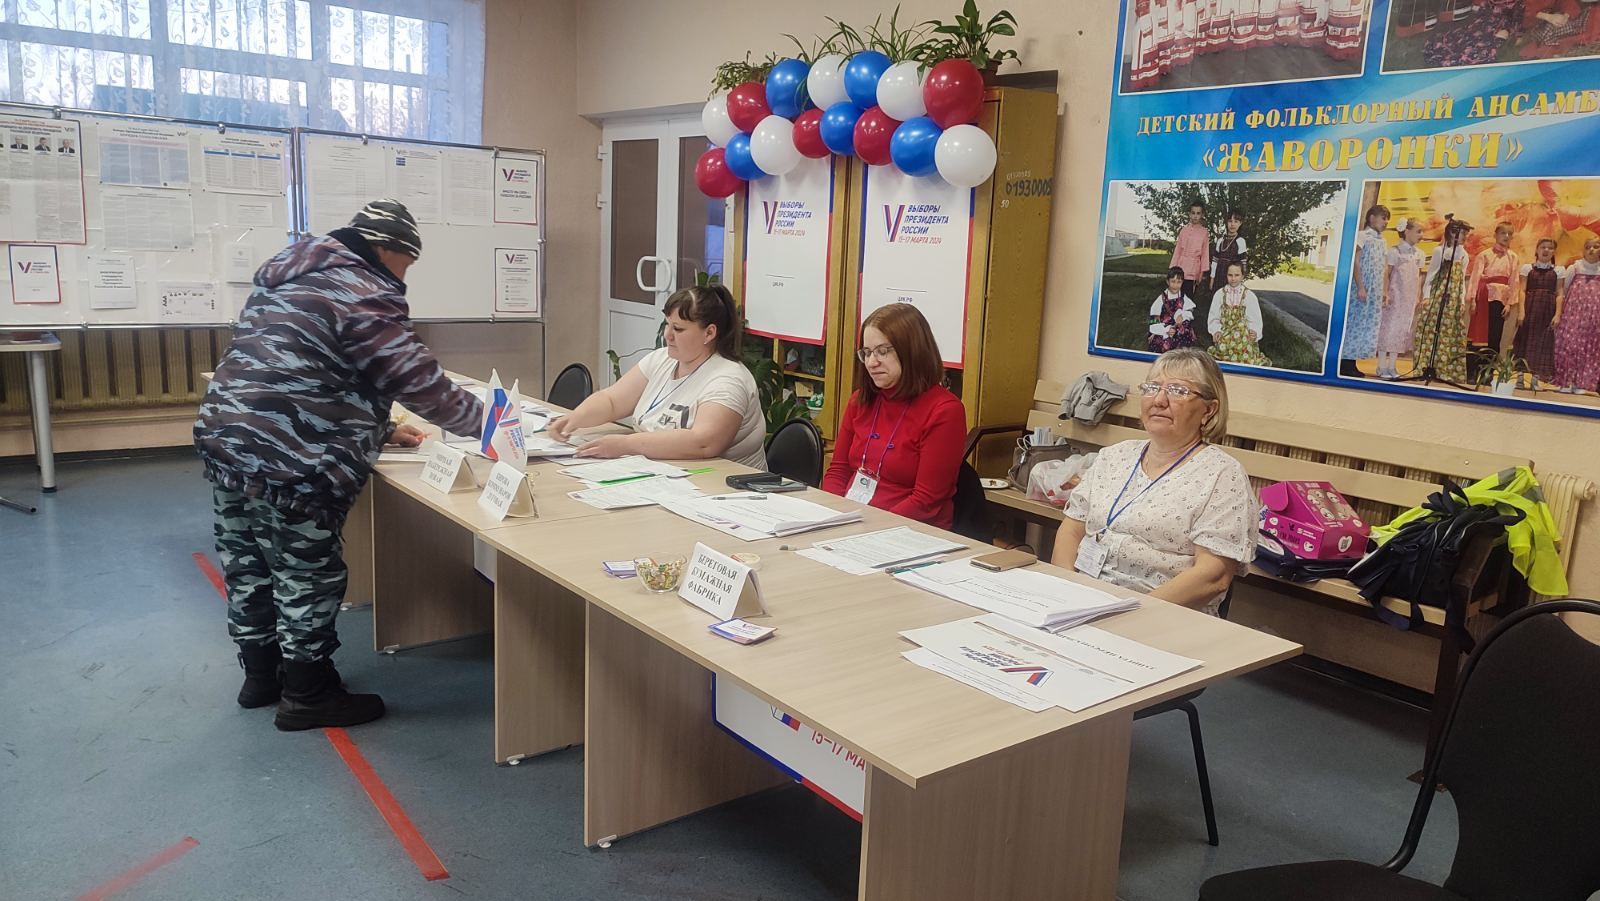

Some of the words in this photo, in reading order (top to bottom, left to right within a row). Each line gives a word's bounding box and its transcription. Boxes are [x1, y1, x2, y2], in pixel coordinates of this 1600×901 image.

[1137, 106, 1235, 136] ДЕТСКИЙ
[1245, 93, 1454, 129] ФОЛЬКЛОРНЫЙ
[1202, 133, 1524, 173] «ЖАВОРОНКИ»
[779, 200, 805, 209] ВЫБОРЫ
[907, 204, 941, 213] ВЫБОРЫ
[777, 210, 812, 219] ПРЕЗИДЕНТА
[775, 219, 795, 228] РОССИИ
[904, 215, 950, 225] ПРЕЗИДЕНТА
[901, 225, 929, 235] РОССИИ
[910, 236, 928, 244] МАРТА
[697, 553, 739, 581] БЕРЕГОВАЯ
[687, 580, 722, 606] ФАБРИКА
